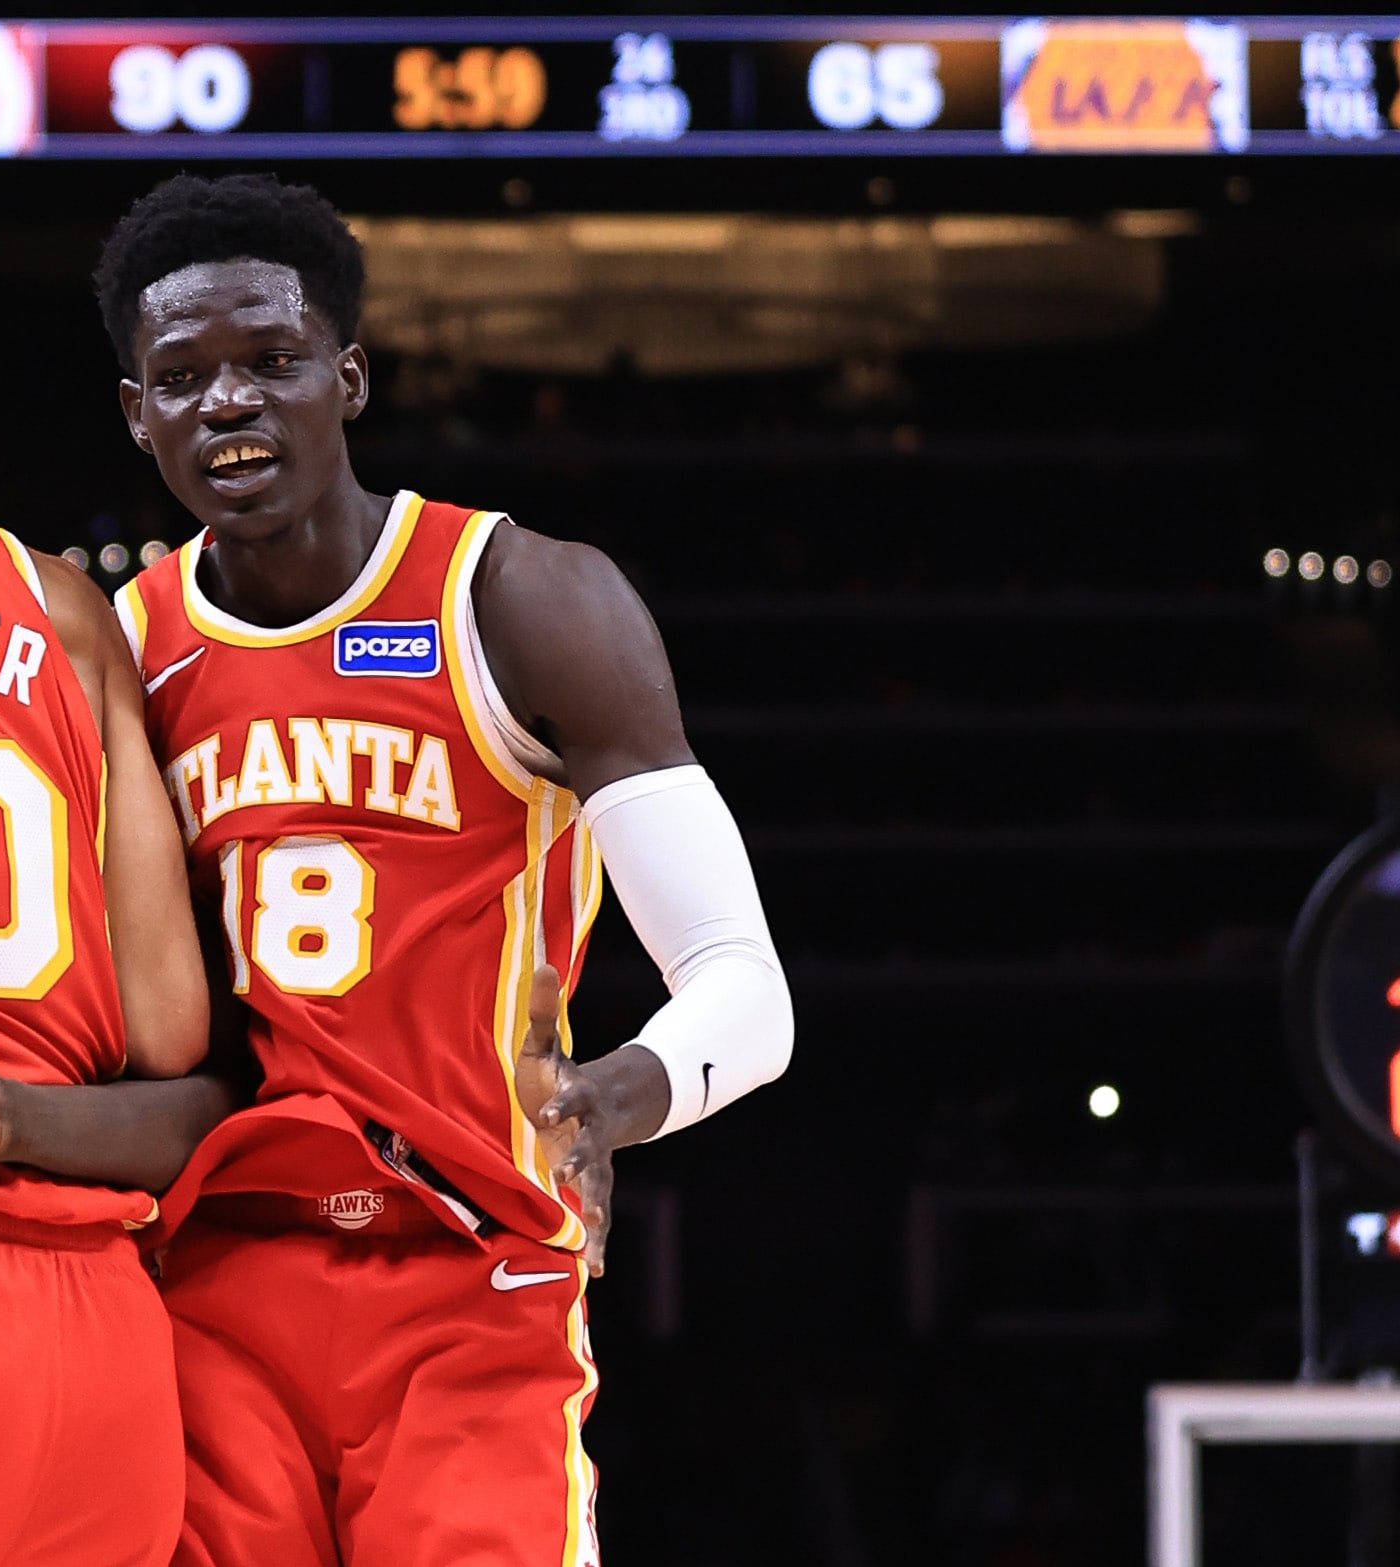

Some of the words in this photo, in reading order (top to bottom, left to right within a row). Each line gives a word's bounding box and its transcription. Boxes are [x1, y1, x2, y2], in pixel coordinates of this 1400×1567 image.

[110, 44, 249, 132] 90
[394, 47, 545, 130] 5:59
[808, 42, 943, 130] 65
[344, 633, 432, 663] paze
[162, 717, 461, 847] TLANTA
[219, 834, 376, 997] 18
[318, 1194, 384, 1215] HAWKS
